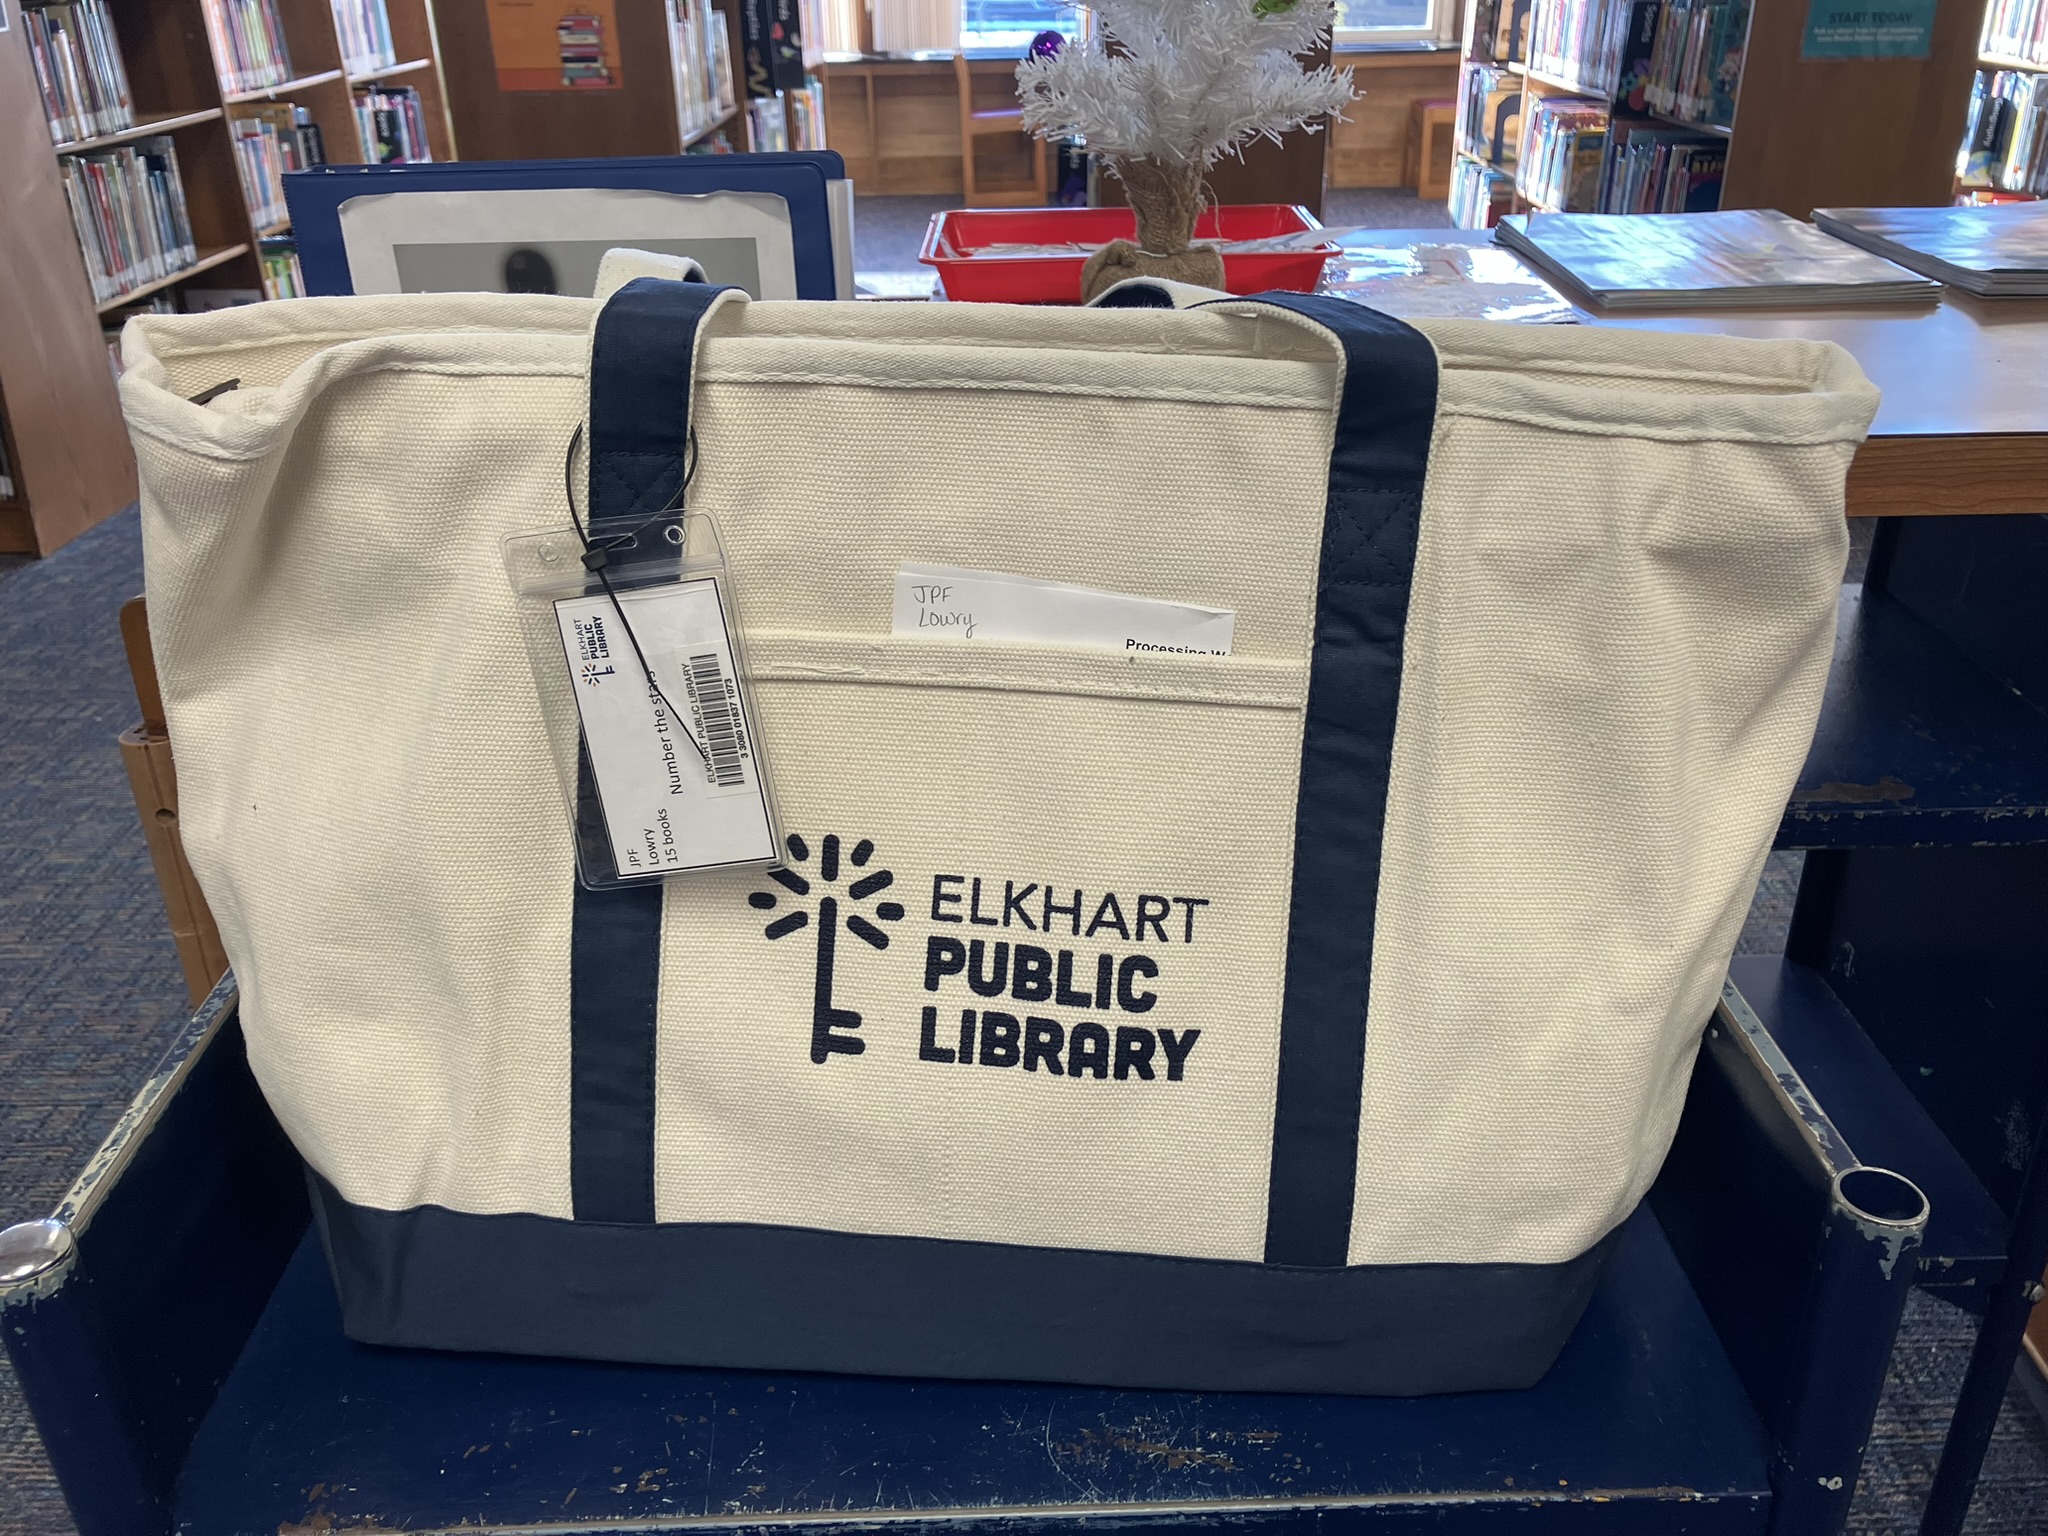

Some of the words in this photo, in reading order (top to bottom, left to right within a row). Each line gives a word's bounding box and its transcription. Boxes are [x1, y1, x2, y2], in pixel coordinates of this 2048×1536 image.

[1829, 11, 1868, 24] START
[911, 585, 953, 605] JPF
[573, 619, 590, 660] ELKHART
[592, 616, 610, 658] LIBRARY
[918, 607, 979, 639] Lowry
[584, 623, 600, 660] PUBLIC
[682, 663, 698, 704] LIBRARY
[724, 678, 736, 699] 1073
[654, 709, 668, 734] the
[691, 705, 706, 739] PUBLIC
[730, 702, 742, 728] 01837
[735, 730, 747, 751] 3080
[662, 737, 683, 795] Number
[699, 741, 716, 783] ELKHART
[657, 808, 674, 845] books
[627, 849, 641, 867] JPF
[643, 829, 660, 865] Lowry
[665, 848, 678, 863] 15
[931, 874, 1209, 943] ELKHART
[924, 936, 1159, 1013] PUBLIC
[919, 1006, 1201, 1081] LIBRARY
